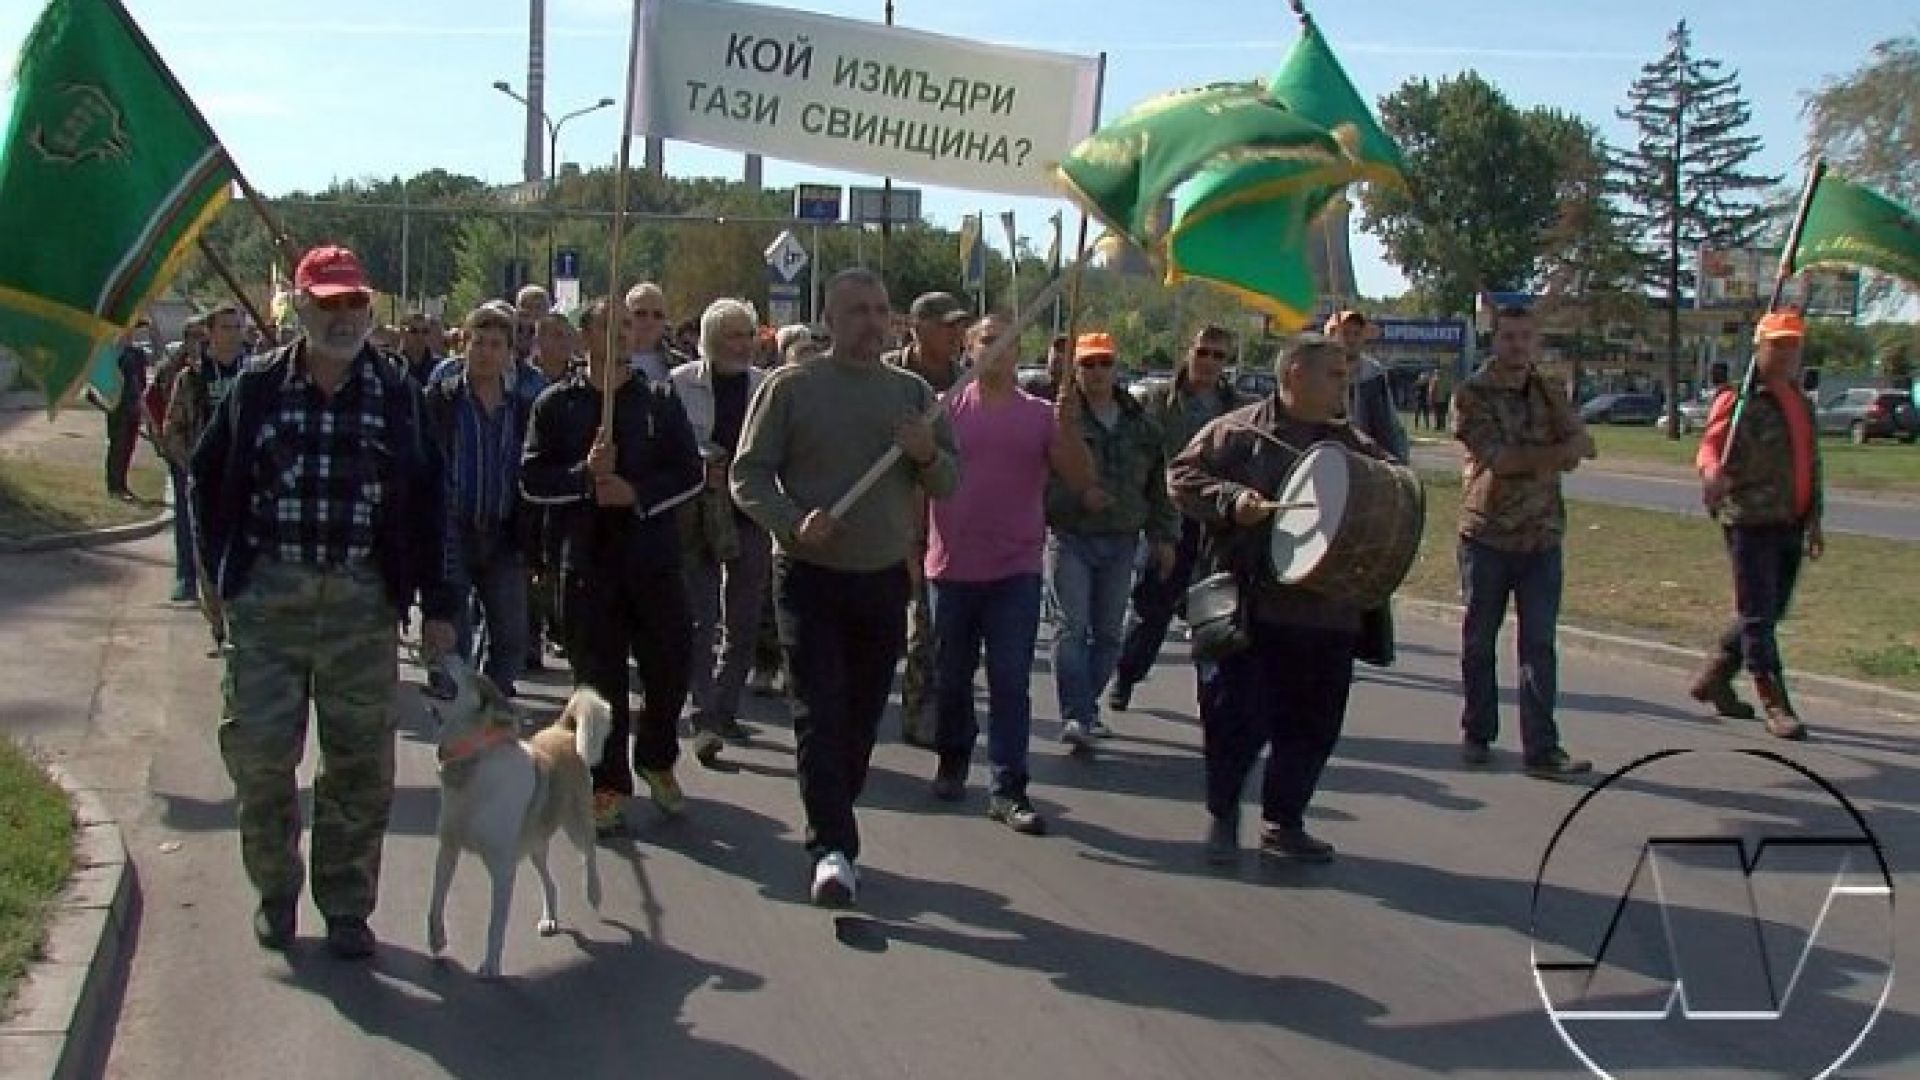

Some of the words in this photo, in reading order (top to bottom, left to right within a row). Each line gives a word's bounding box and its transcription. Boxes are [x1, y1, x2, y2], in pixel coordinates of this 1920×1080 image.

[725, 32, 815, 81] КОЙ
[832, 55, 1016, 117] ИЗМЪДРИ
[686, 81, 781, 127] ТАЗИ
[800, 102, 1033, 169] СВИНЩИНА?
